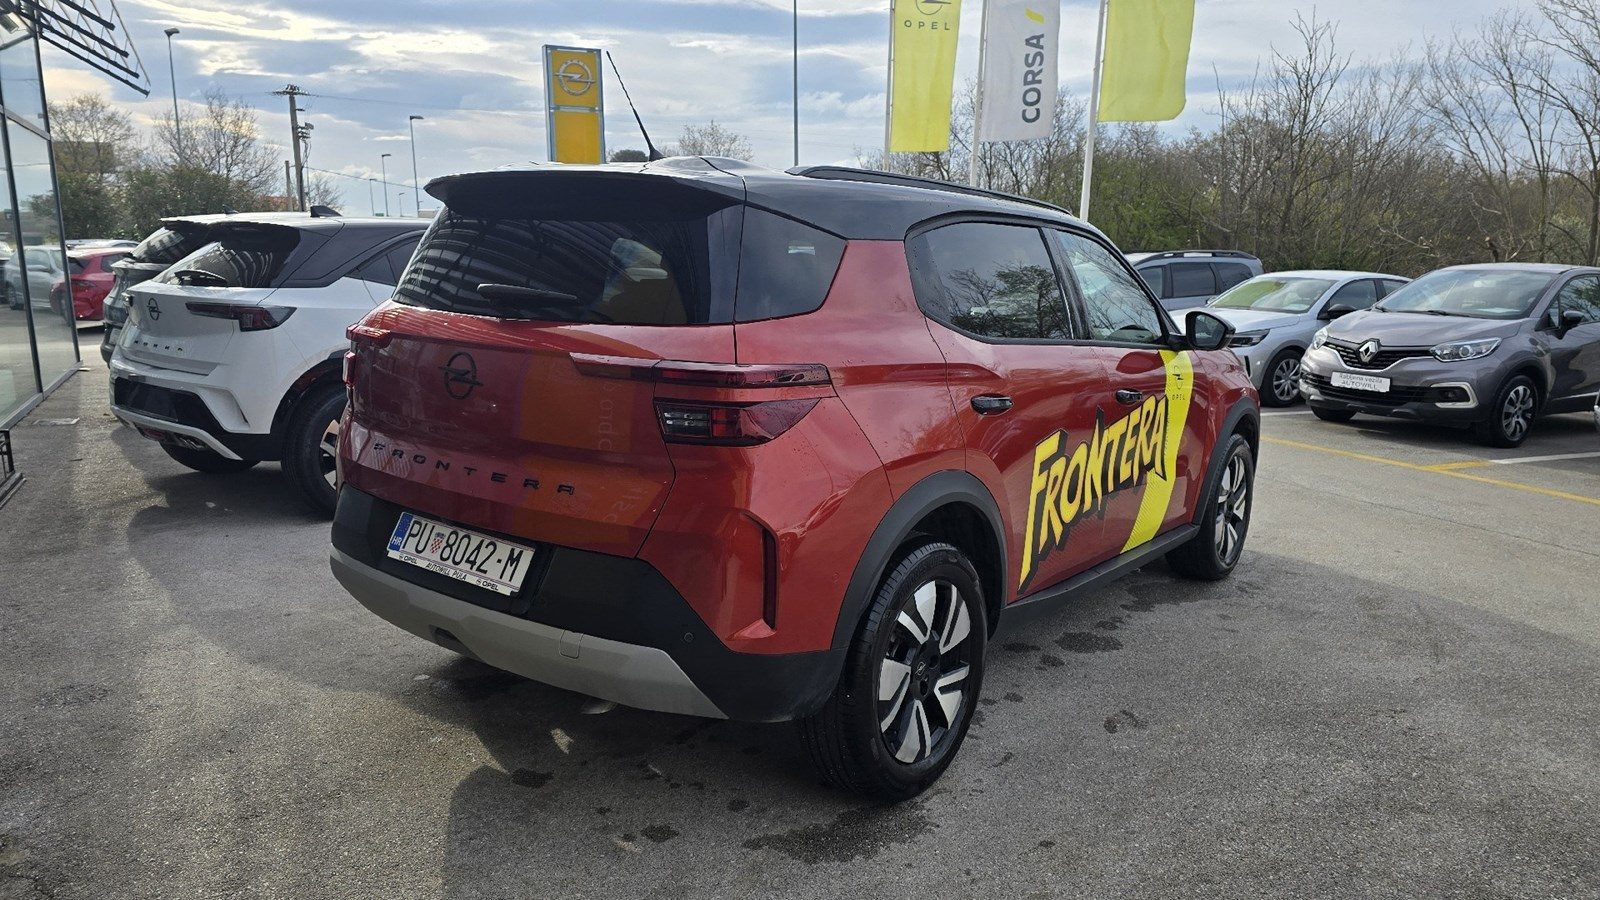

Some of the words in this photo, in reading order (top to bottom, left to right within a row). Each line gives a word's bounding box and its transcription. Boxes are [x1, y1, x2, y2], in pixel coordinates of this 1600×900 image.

[904, 20, 950, 31] OPEL
[1021, 33, 1045, 124] CORSA
[373, 443, 576, 496] FRONTERA
[1018, 394, 1168, 595] FRONTERA
[391, 536, 402, 546] HR
[402, 520, 436, 555] PU
[439, 530, 524, 582] 8042-M
[403, 555, 418, 565] OPEL
[481, 581, 499, 591] OPEL
